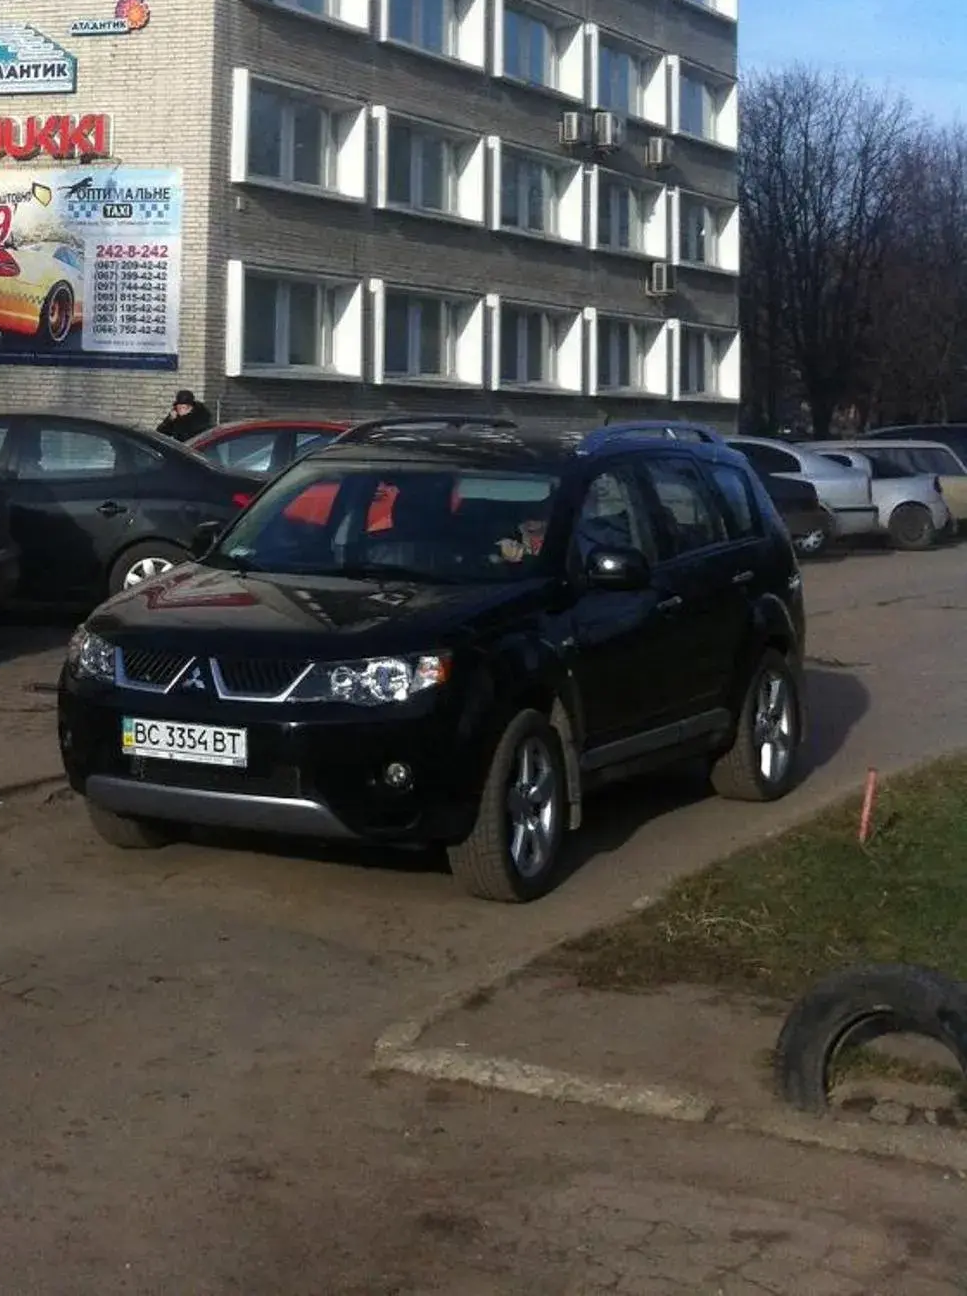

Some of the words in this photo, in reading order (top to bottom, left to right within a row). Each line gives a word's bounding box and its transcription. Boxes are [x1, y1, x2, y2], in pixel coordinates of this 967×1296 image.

[72, 20, 127, 30] АТЛАНТИК
[77, 187, 171, 200] ОПТИМАЛЬНЕ
[106, 205, 130, 216] TAXI
[96, 245, 169, 258] 242-8-242
[135, 722, 160, 745] BC
[166, 726, 207, 751] 3354
[213, 731, 241, 754] BT
